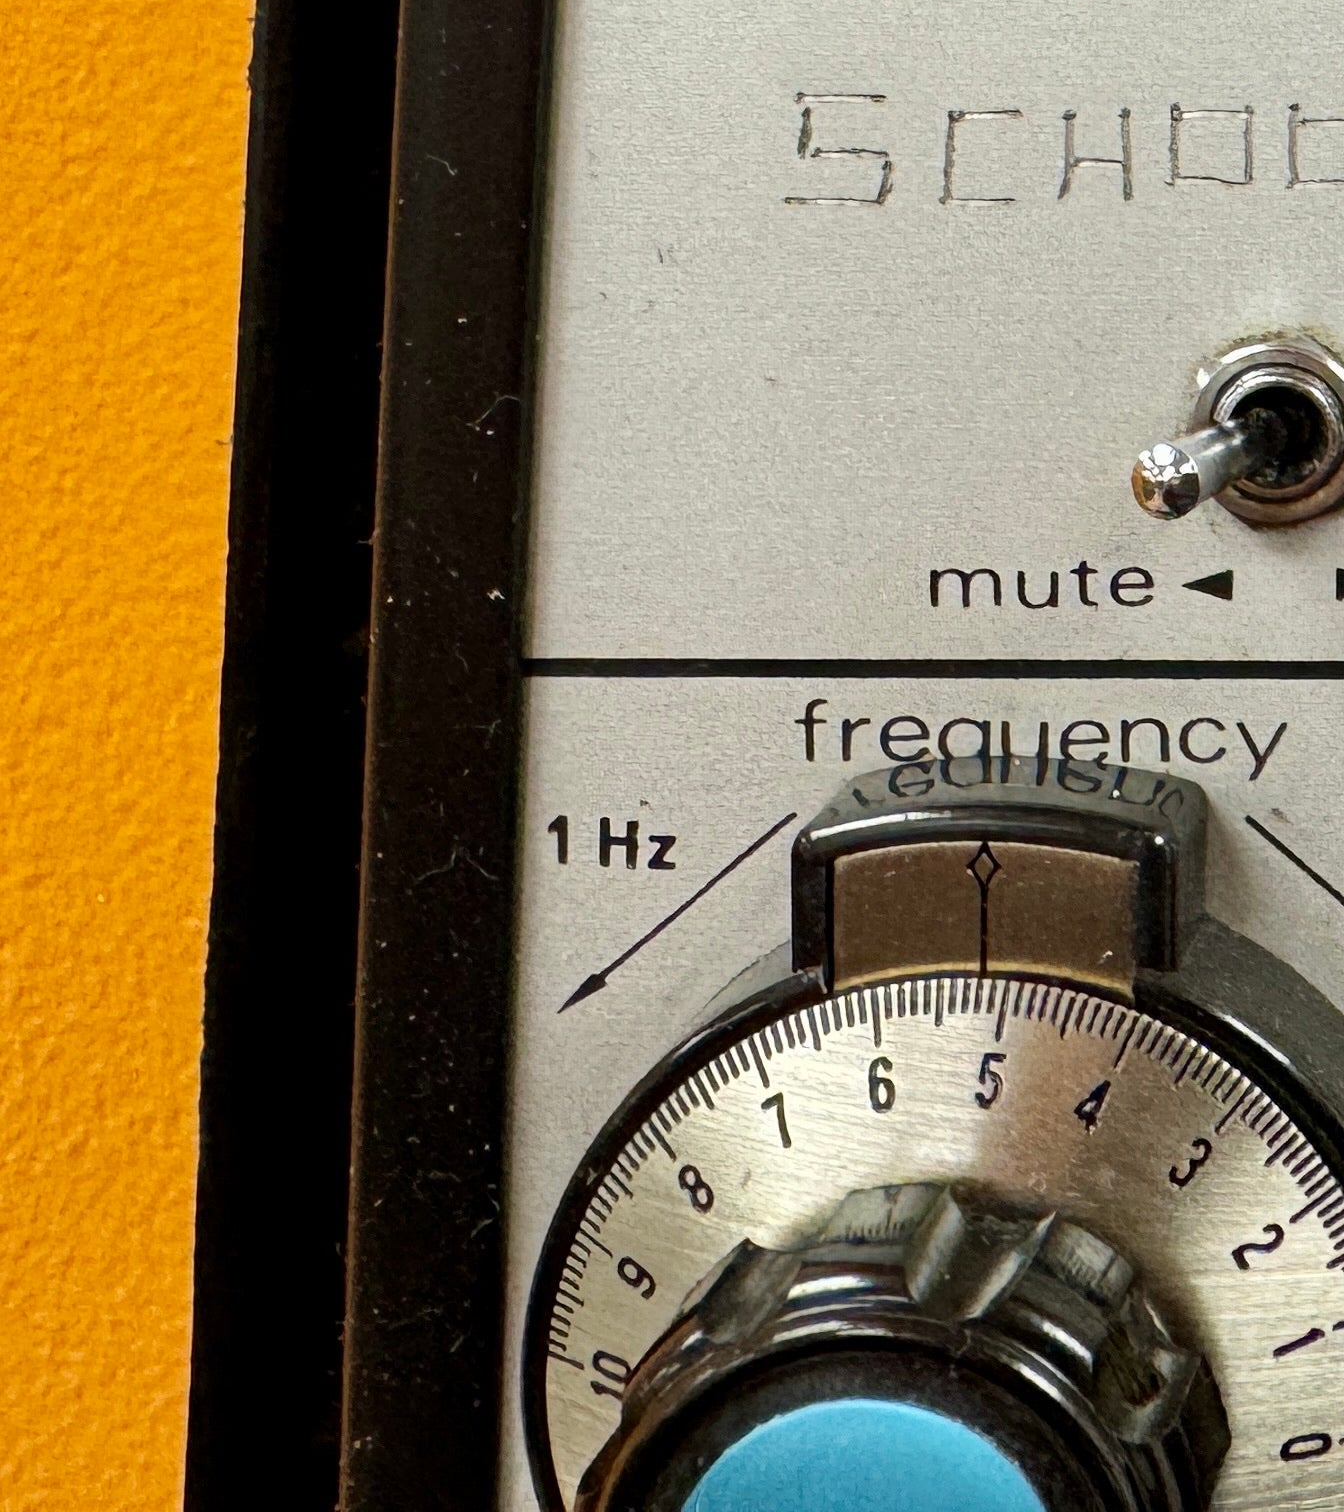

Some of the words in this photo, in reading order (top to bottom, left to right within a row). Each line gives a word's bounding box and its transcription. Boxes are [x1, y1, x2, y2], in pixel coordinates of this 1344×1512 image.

[929, 560, 1155, 610] mute
[794, 698, 1289, 782] frequency
[867, 1056, 896, 1114] 6
[974, 1052, 1007, 1110] 5
[1073, 1079, 1112, 1134] 4
[760, 1091, 792, 1149] 7
[677, 1164, 715, 1214] 8
[1168, 1136, 1213, 1190] 3
[1231, 1223, 1285, 1271] 2
[617, 1255, 657, 1300] 9
[1272, 1327, 1326, 1358] 1
[590, 1349, 634, 1402] 10
[1279, 1432, 1333, 1463] 0
